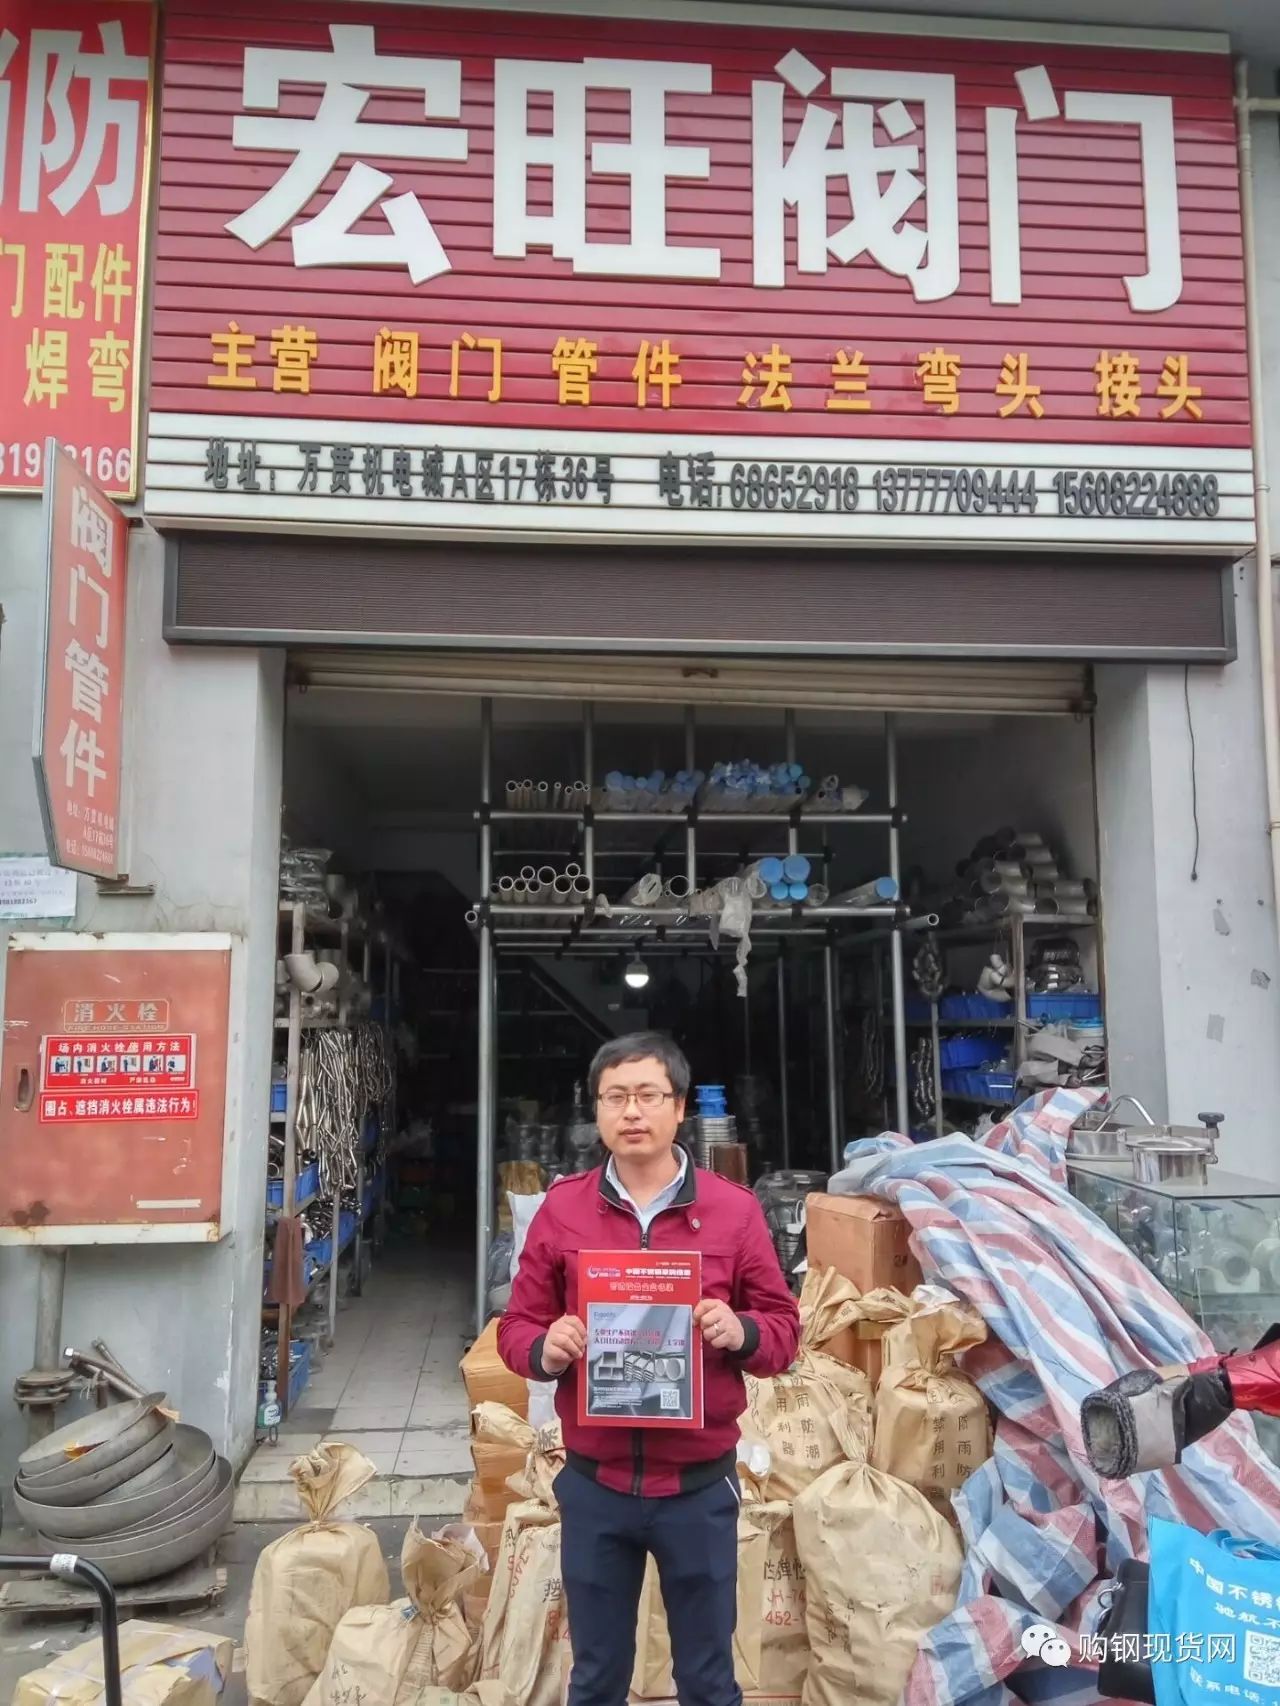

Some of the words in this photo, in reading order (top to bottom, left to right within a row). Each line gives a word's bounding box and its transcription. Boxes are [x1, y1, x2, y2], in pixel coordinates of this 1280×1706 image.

[0, 20, 149, 216] 防
[223, 23, 1184, 314] 宏旺阀门
[44, 243, 132, 324] 配件
[207, 321, 318, 394] 主营
[373, 326, 502, 402] 阀门
[551, 337, 682, 408] 管件
[737, 343, 872, 412] 法兰
[914, 347, 1044, 418] 弯头
[1095, 351, 1203, 419] 接头
[873, 468, 1038, 513] 13777709444
[1052, 471, 1220, 517] 15608224888
[60, 486, 114, 798] 阀门管件
[58, 1041, 181, 1053] 场内消火栓使用方法
[74, 1002, 159, 1022] 消火栓
[1189, 1557, 1280, 1613] 中国不锈
